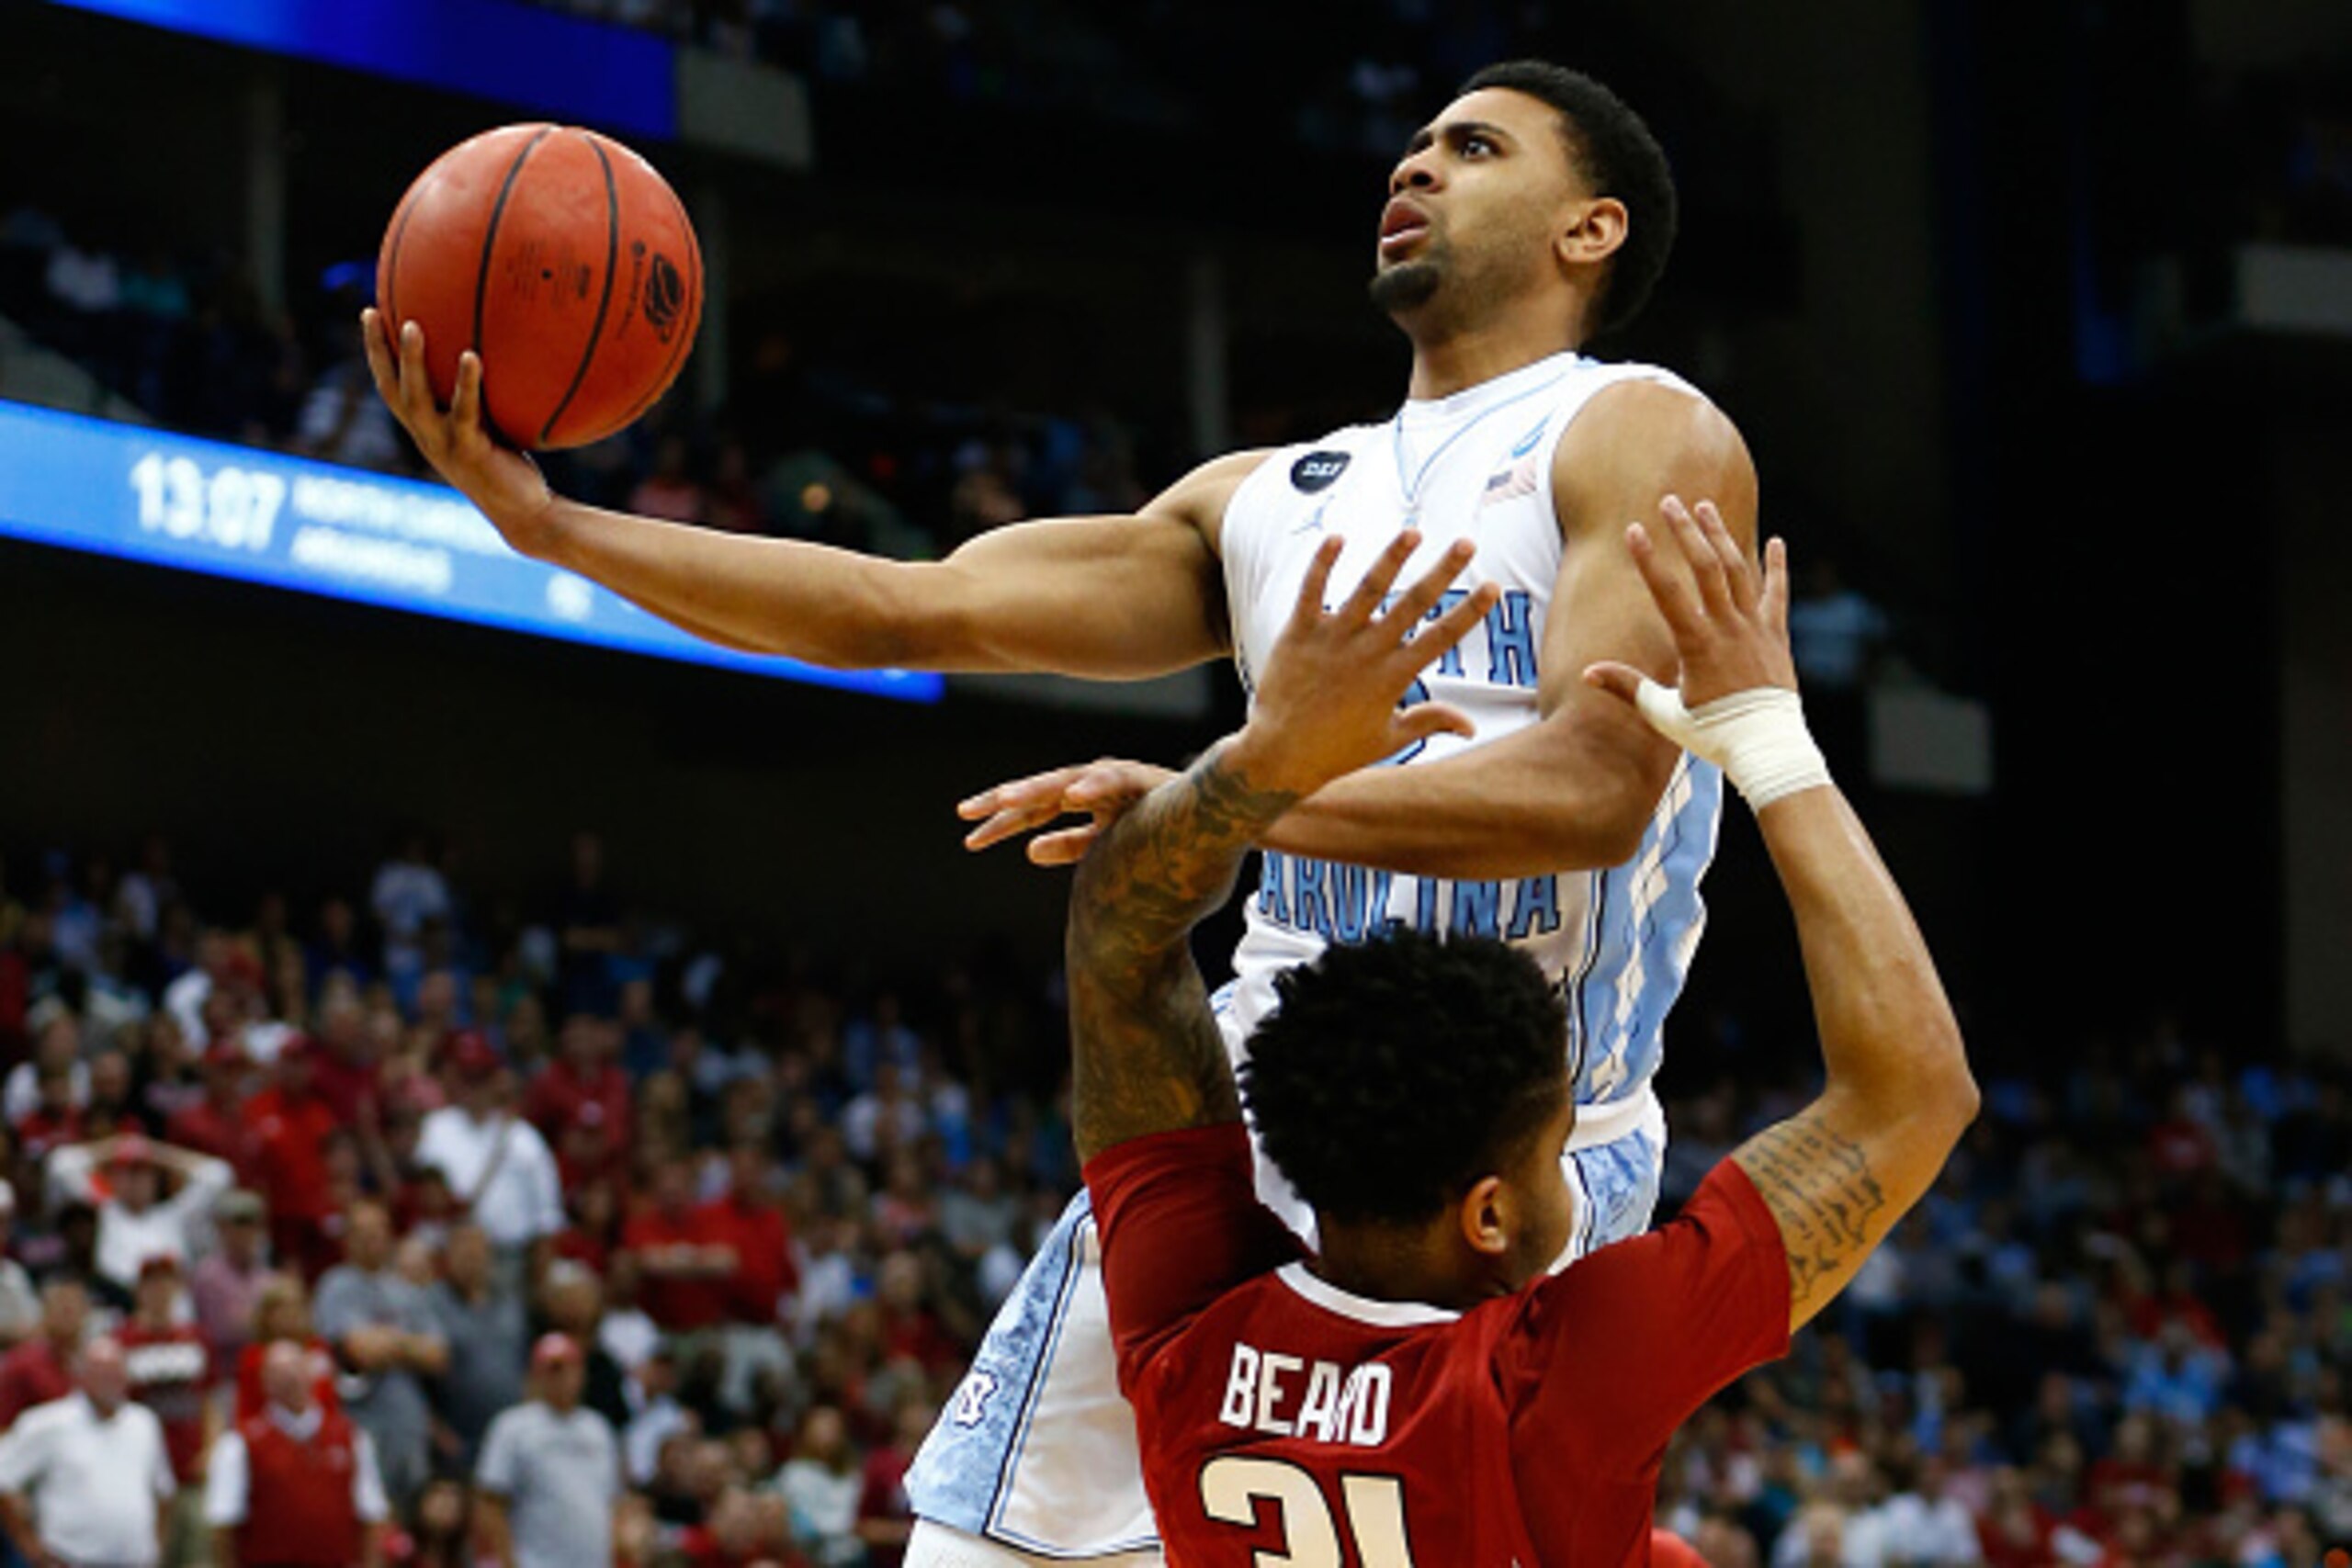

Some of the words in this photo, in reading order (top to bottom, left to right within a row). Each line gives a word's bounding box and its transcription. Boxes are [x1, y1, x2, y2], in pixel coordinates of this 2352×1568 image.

[130, 453, 285, 552] 13:07
[1258, 850, 1560, 944] AROLINA
[1198, 1453, 1415, 1568] 31
